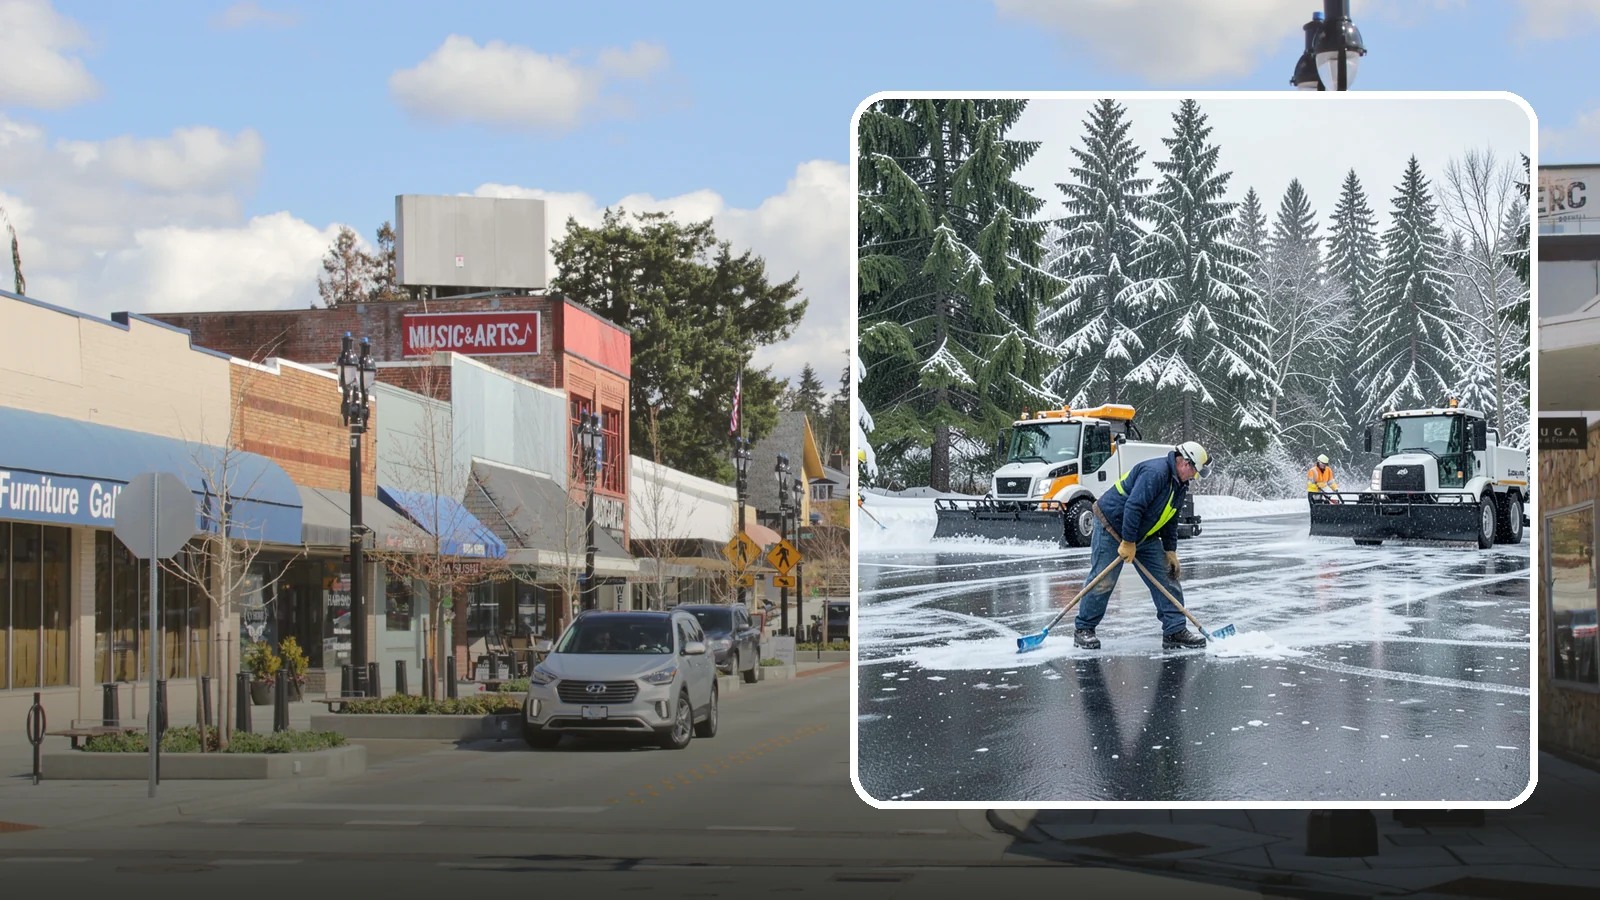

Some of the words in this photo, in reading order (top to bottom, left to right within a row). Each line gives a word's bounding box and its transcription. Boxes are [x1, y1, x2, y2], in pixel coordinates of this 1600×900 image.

[408, 323, 519, 348] MUSIC&ARTS
[1540, 427, 1577, 436] UGA
[0, 471, 79, 515] Furniture
[89, 482, 121, 519] Gal
[453, 563, 480, 574] SUSHI
